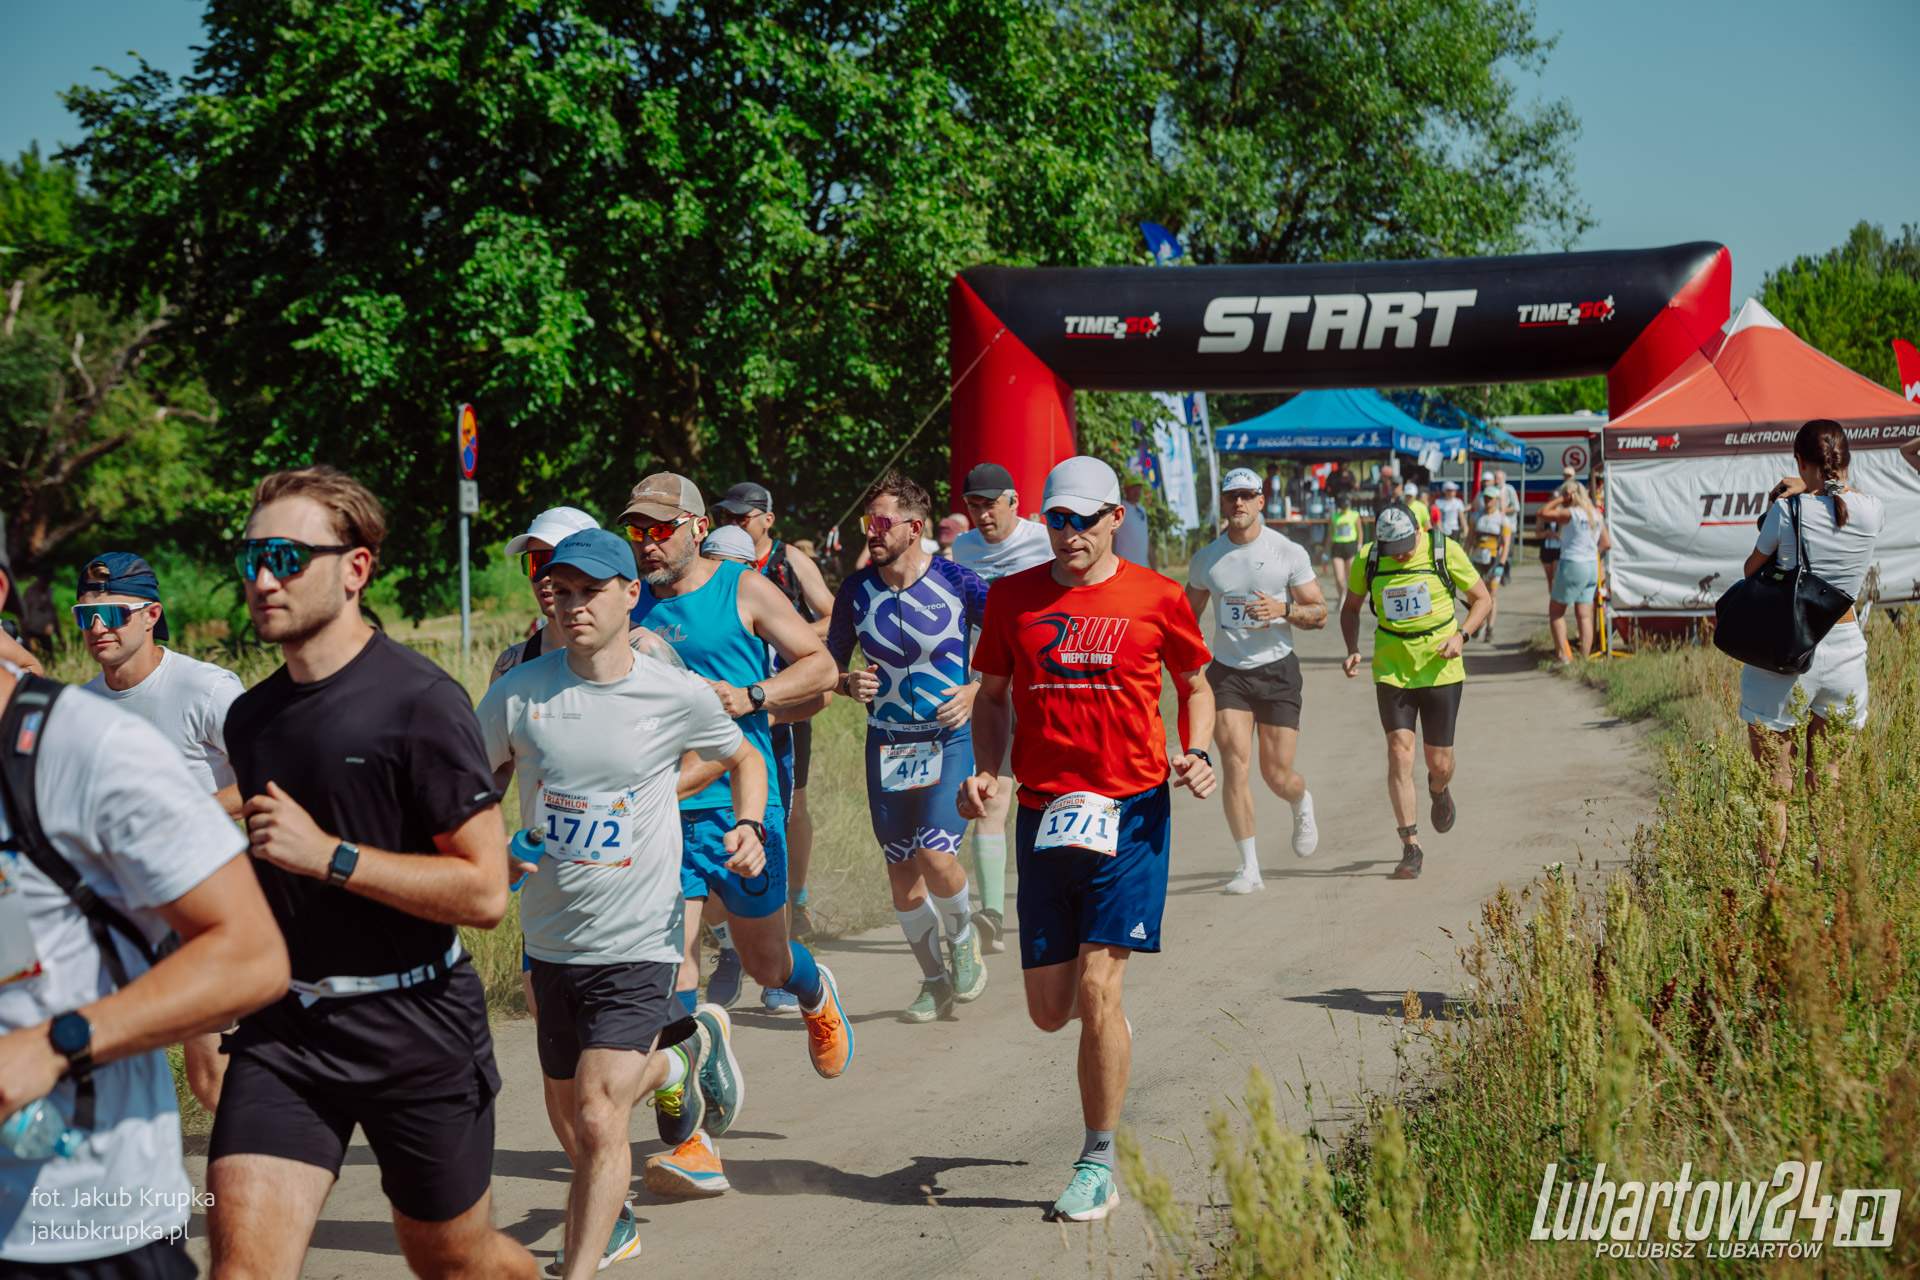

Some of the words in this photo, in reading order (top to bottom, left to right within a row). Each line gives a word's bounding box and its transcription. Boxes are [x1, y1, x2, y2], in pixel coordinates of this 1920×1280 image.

[1197, 289, 1478, 353] START
[1842, 427, 1879, 440] MIAR
[1570, 451, 1581, 465] S
[1394, 596, 1421, 612] 3/1
[1057, 616, 1130, 654] RUN
[1060, 652, 1089, 664] WIEPRZ
[1090, 653, 1113, 665] RIVER
[896, 759, 929, 779] 4/1
[546, 814, 621, 849] 17/2
[1046, 811, 1109, 840] 17/1
